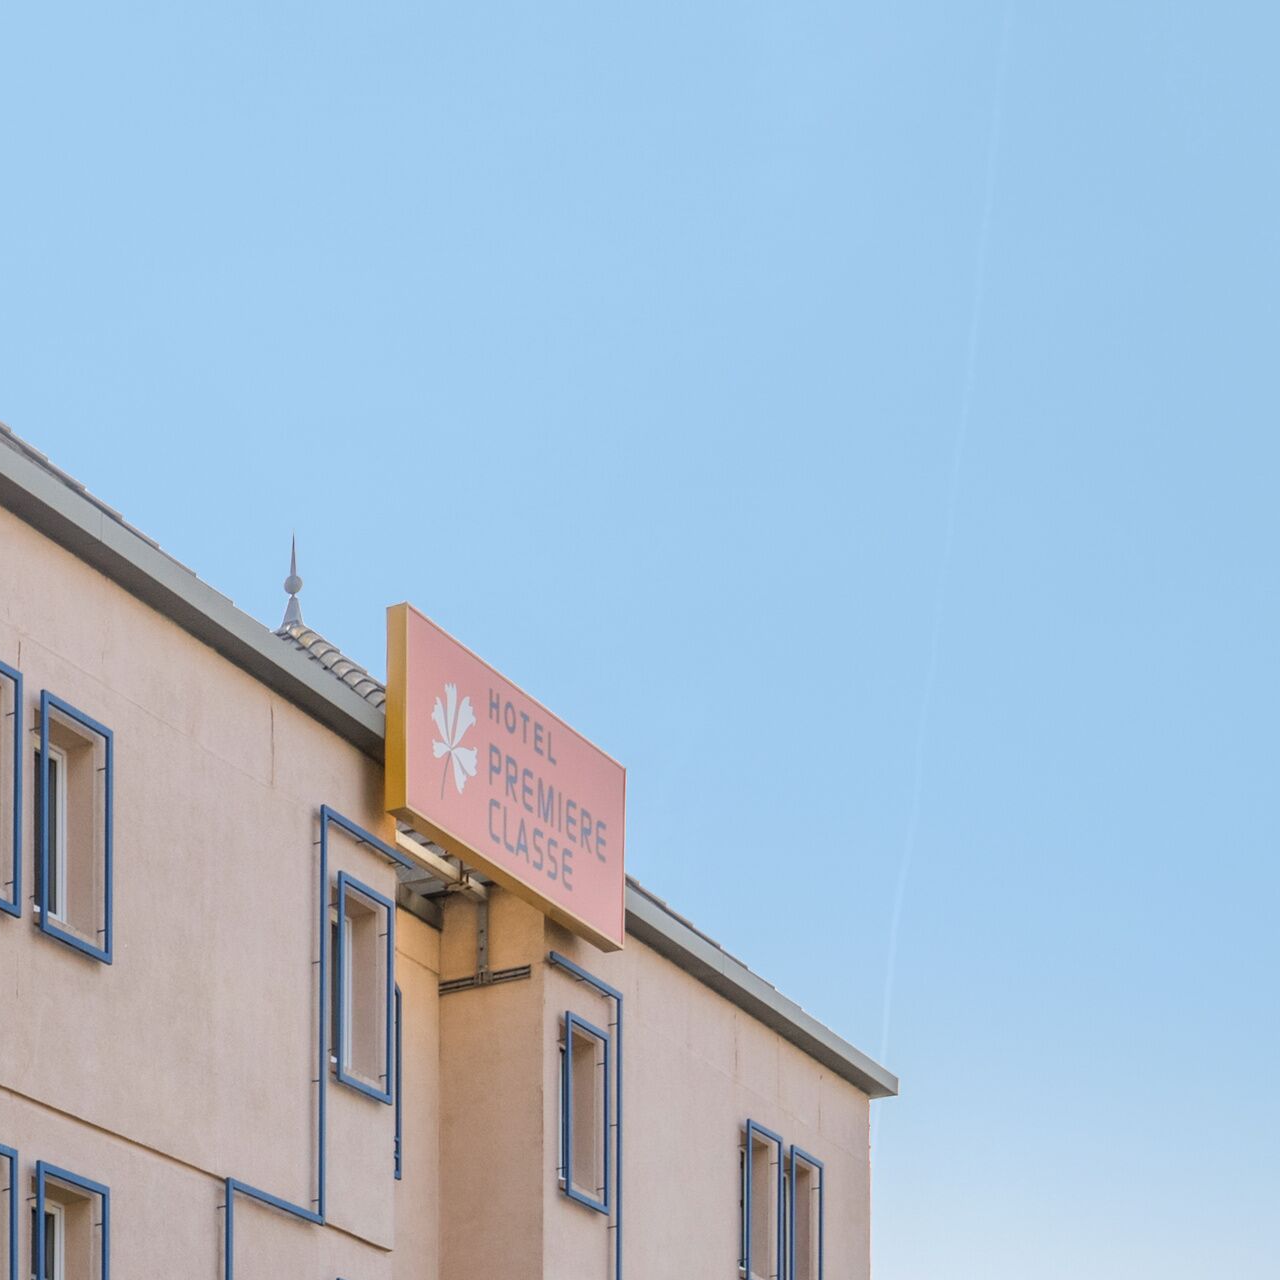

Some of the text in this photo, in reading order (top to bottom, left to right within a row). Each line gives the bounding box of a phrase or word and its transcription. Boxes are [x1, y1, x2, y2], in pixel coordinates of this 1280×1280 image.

[489, 688, 557, 766] HOTEL
[489, 744, 608, 863] PREMIERE
[489, 799, 573, 892] CLASSE
